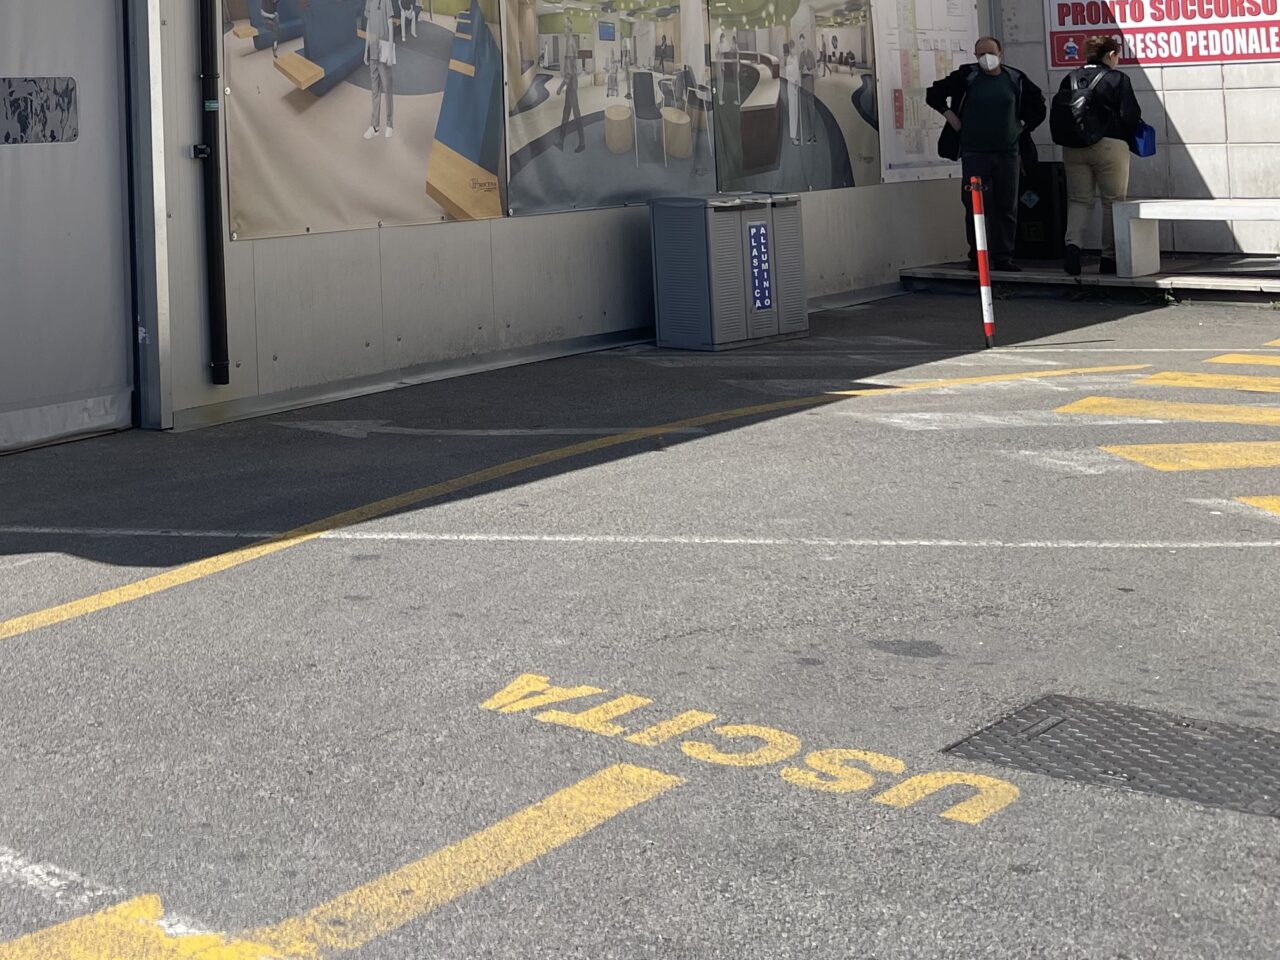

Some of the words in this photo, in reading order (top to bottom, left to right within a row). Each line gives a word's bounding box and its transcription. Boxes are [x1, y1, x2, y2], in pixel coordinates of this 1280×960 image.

[1186, 26, 1280, 57] PEDONALE
[750, 227, 761, 308] PLASTICA
[760, 227, 771, 306] ALLUMINIO
[478, 673, 1020, 825] USCITA
